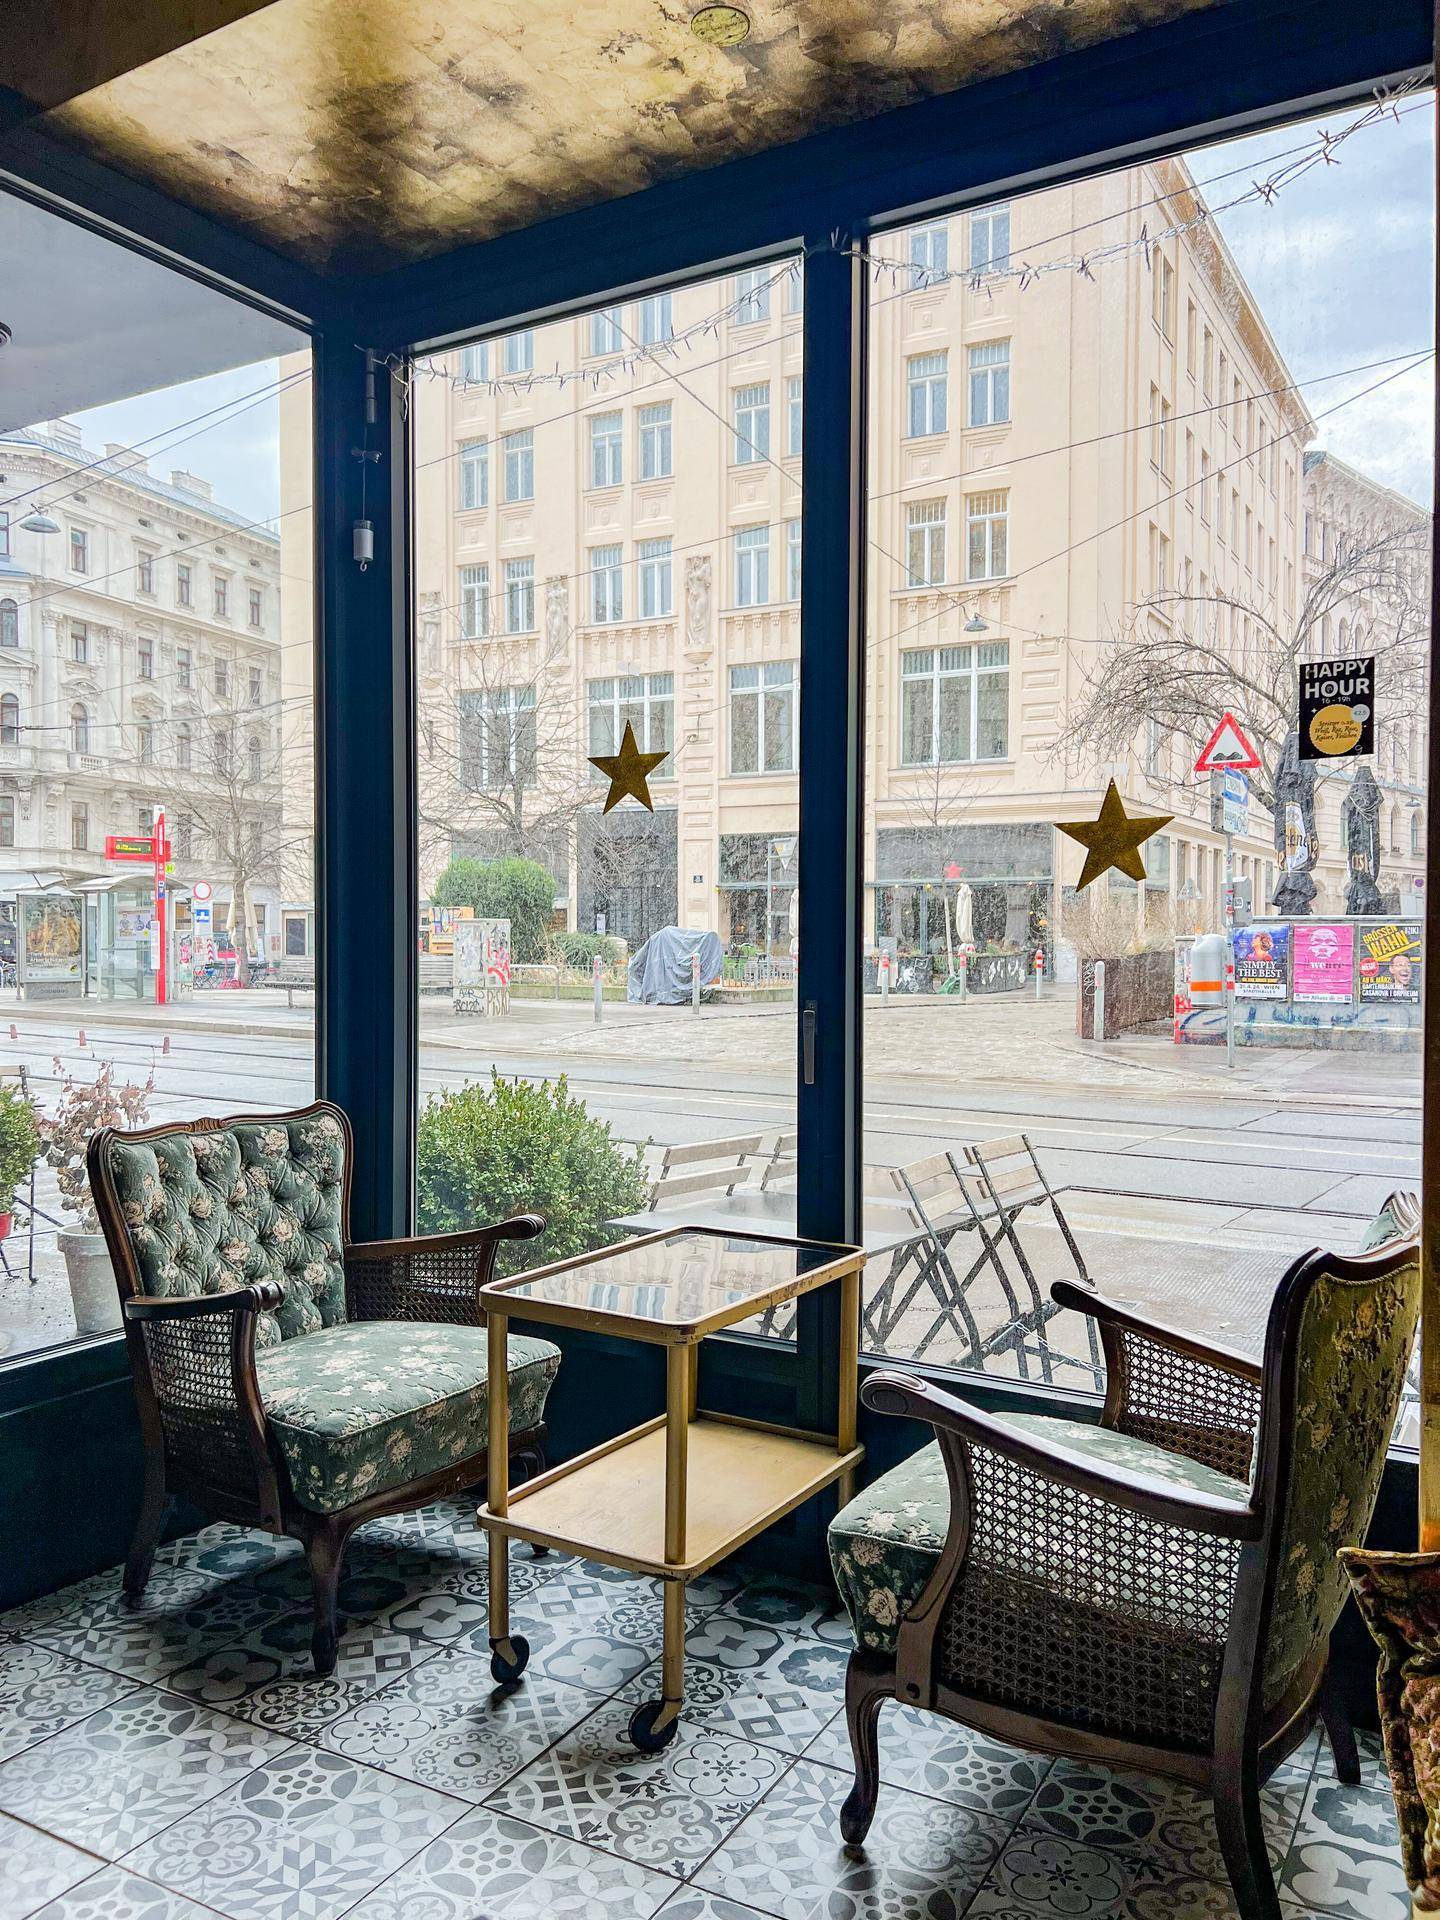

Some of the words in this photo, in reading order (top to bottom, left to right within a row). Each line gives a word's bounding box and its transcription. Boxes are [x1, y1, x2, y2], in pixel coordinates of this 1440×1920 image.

[1305, 660, 1370, 679] HAPPY
[1305, 678, 1370, 699] HOUR
[1366, 930, 1409, 959] WAHN
[1238, 968, 1258, 977] THE
[1259, 969, 1282, 978] BEST
[1242, 960, 1277, 970] SIMPLY
